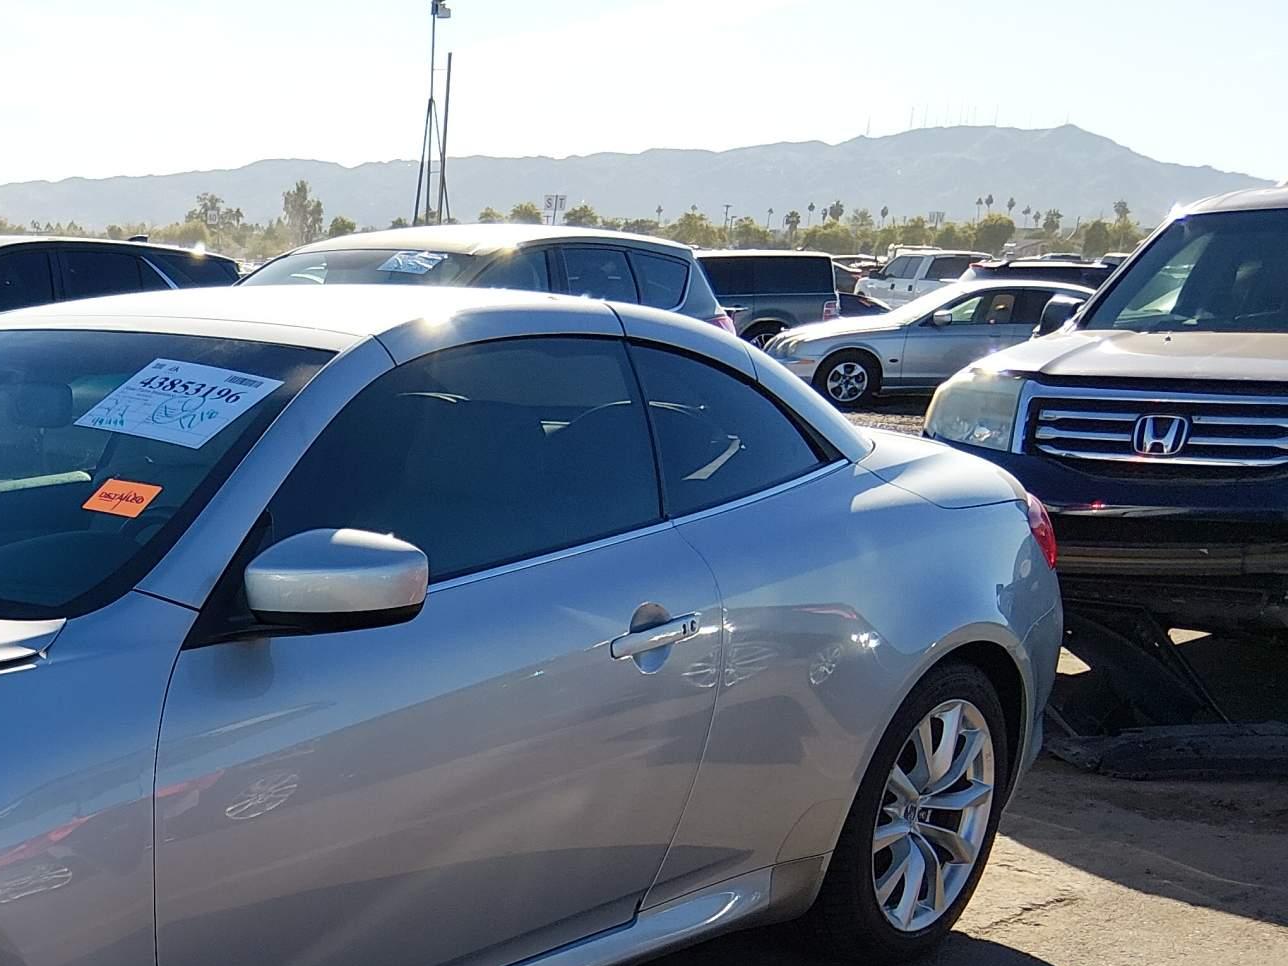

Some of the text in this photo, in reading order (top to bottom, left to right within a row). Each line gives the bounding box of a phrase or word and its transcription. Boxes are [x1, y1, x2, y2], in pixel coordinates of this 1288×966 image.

[545, 197, 565, 209] S T
[140, 375, 247, 404] 43853196
